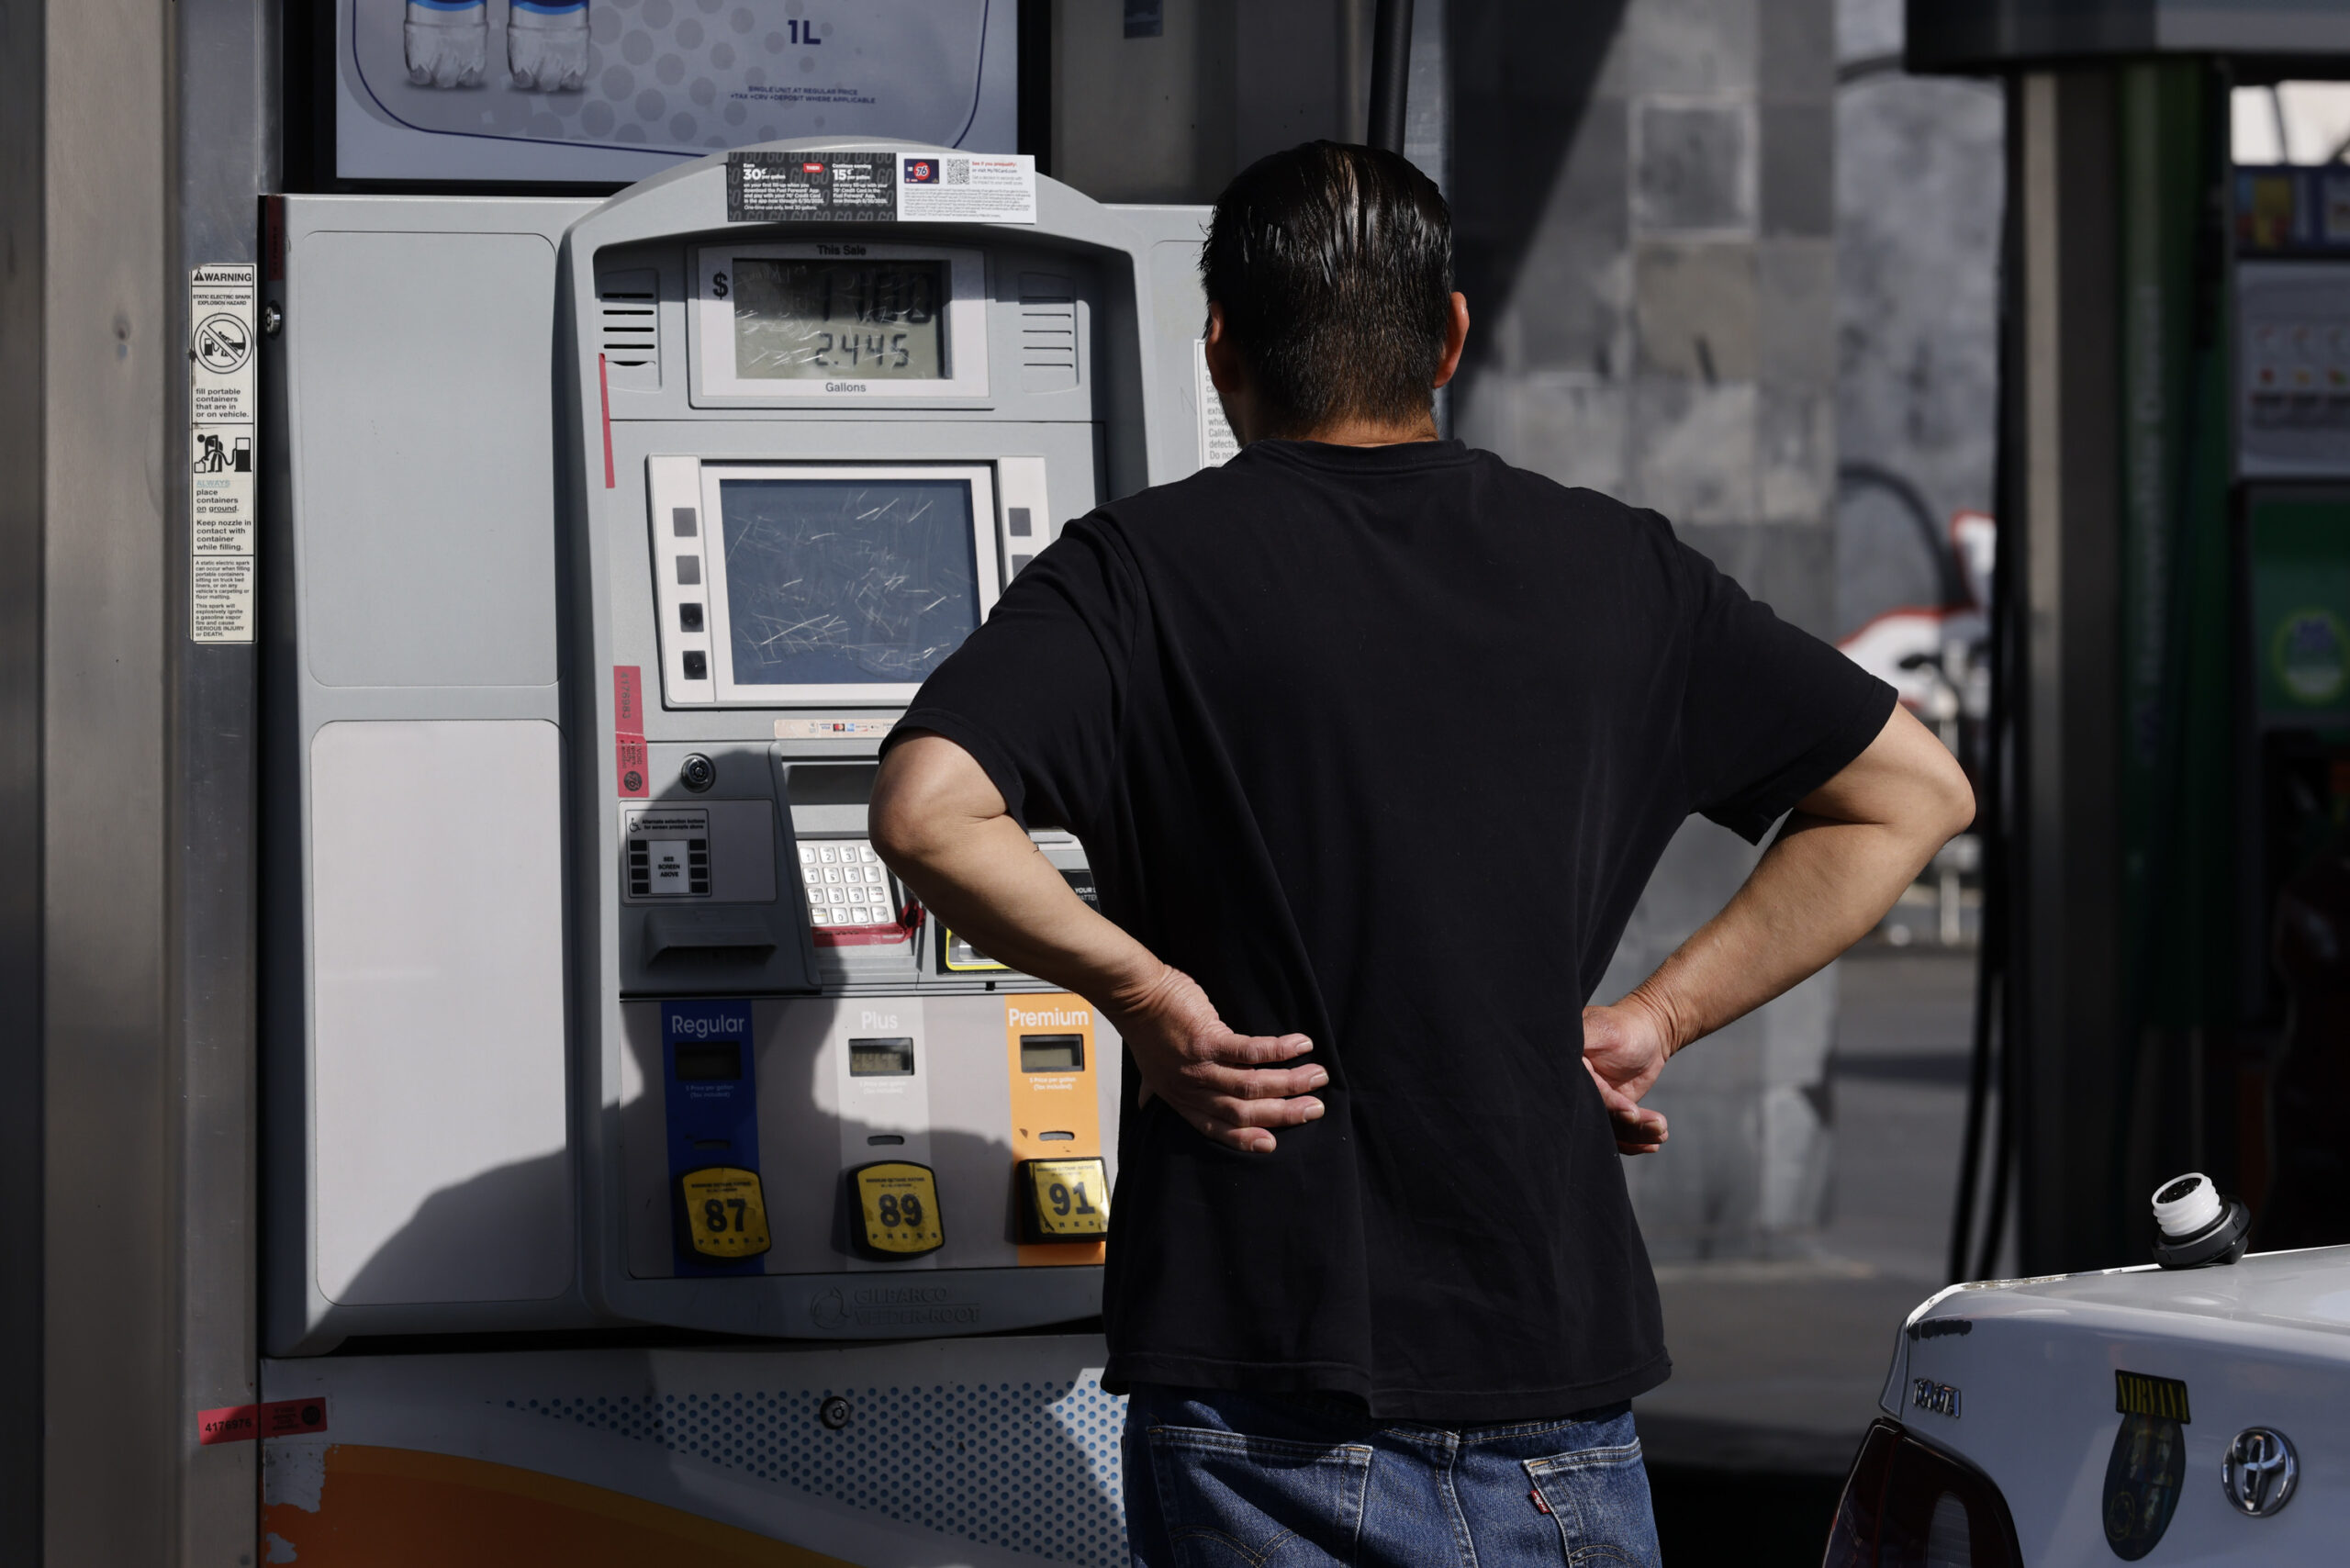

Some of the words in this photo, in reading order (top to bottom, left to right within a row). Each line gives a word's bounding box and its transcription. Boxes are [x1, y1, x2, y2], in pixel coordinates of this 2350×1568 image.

[788, 20, 821, 44] 1L
[917, 167, 927, 177] 76
[817, 245, 841, 255] This
[843, 245, 866, 255] Sale
[204, 273, 252, 282] WARNING
[713, 271, 728, 300] $
[815, 333, 909, 367] 2.445
[825, 382, 866, 392] Gallons
[1210, 451, 1220, 459] Do
[672, 1014, 745, 1038] Regular
[861, 1011, 898, 1030] Plus
[1008, 1007, 1089, 1027] Premium
[1049, 1182, 1096, 1216] 91
[705, 1198, 746, 1232] 87
[879, 1193, 923, 1227] 89
[854, 1287, 947, 1304] GILBARCO
[2118, 1375, 2188, 1421] NIRVANA
[205, 1417, 252, 1433] 4176976
